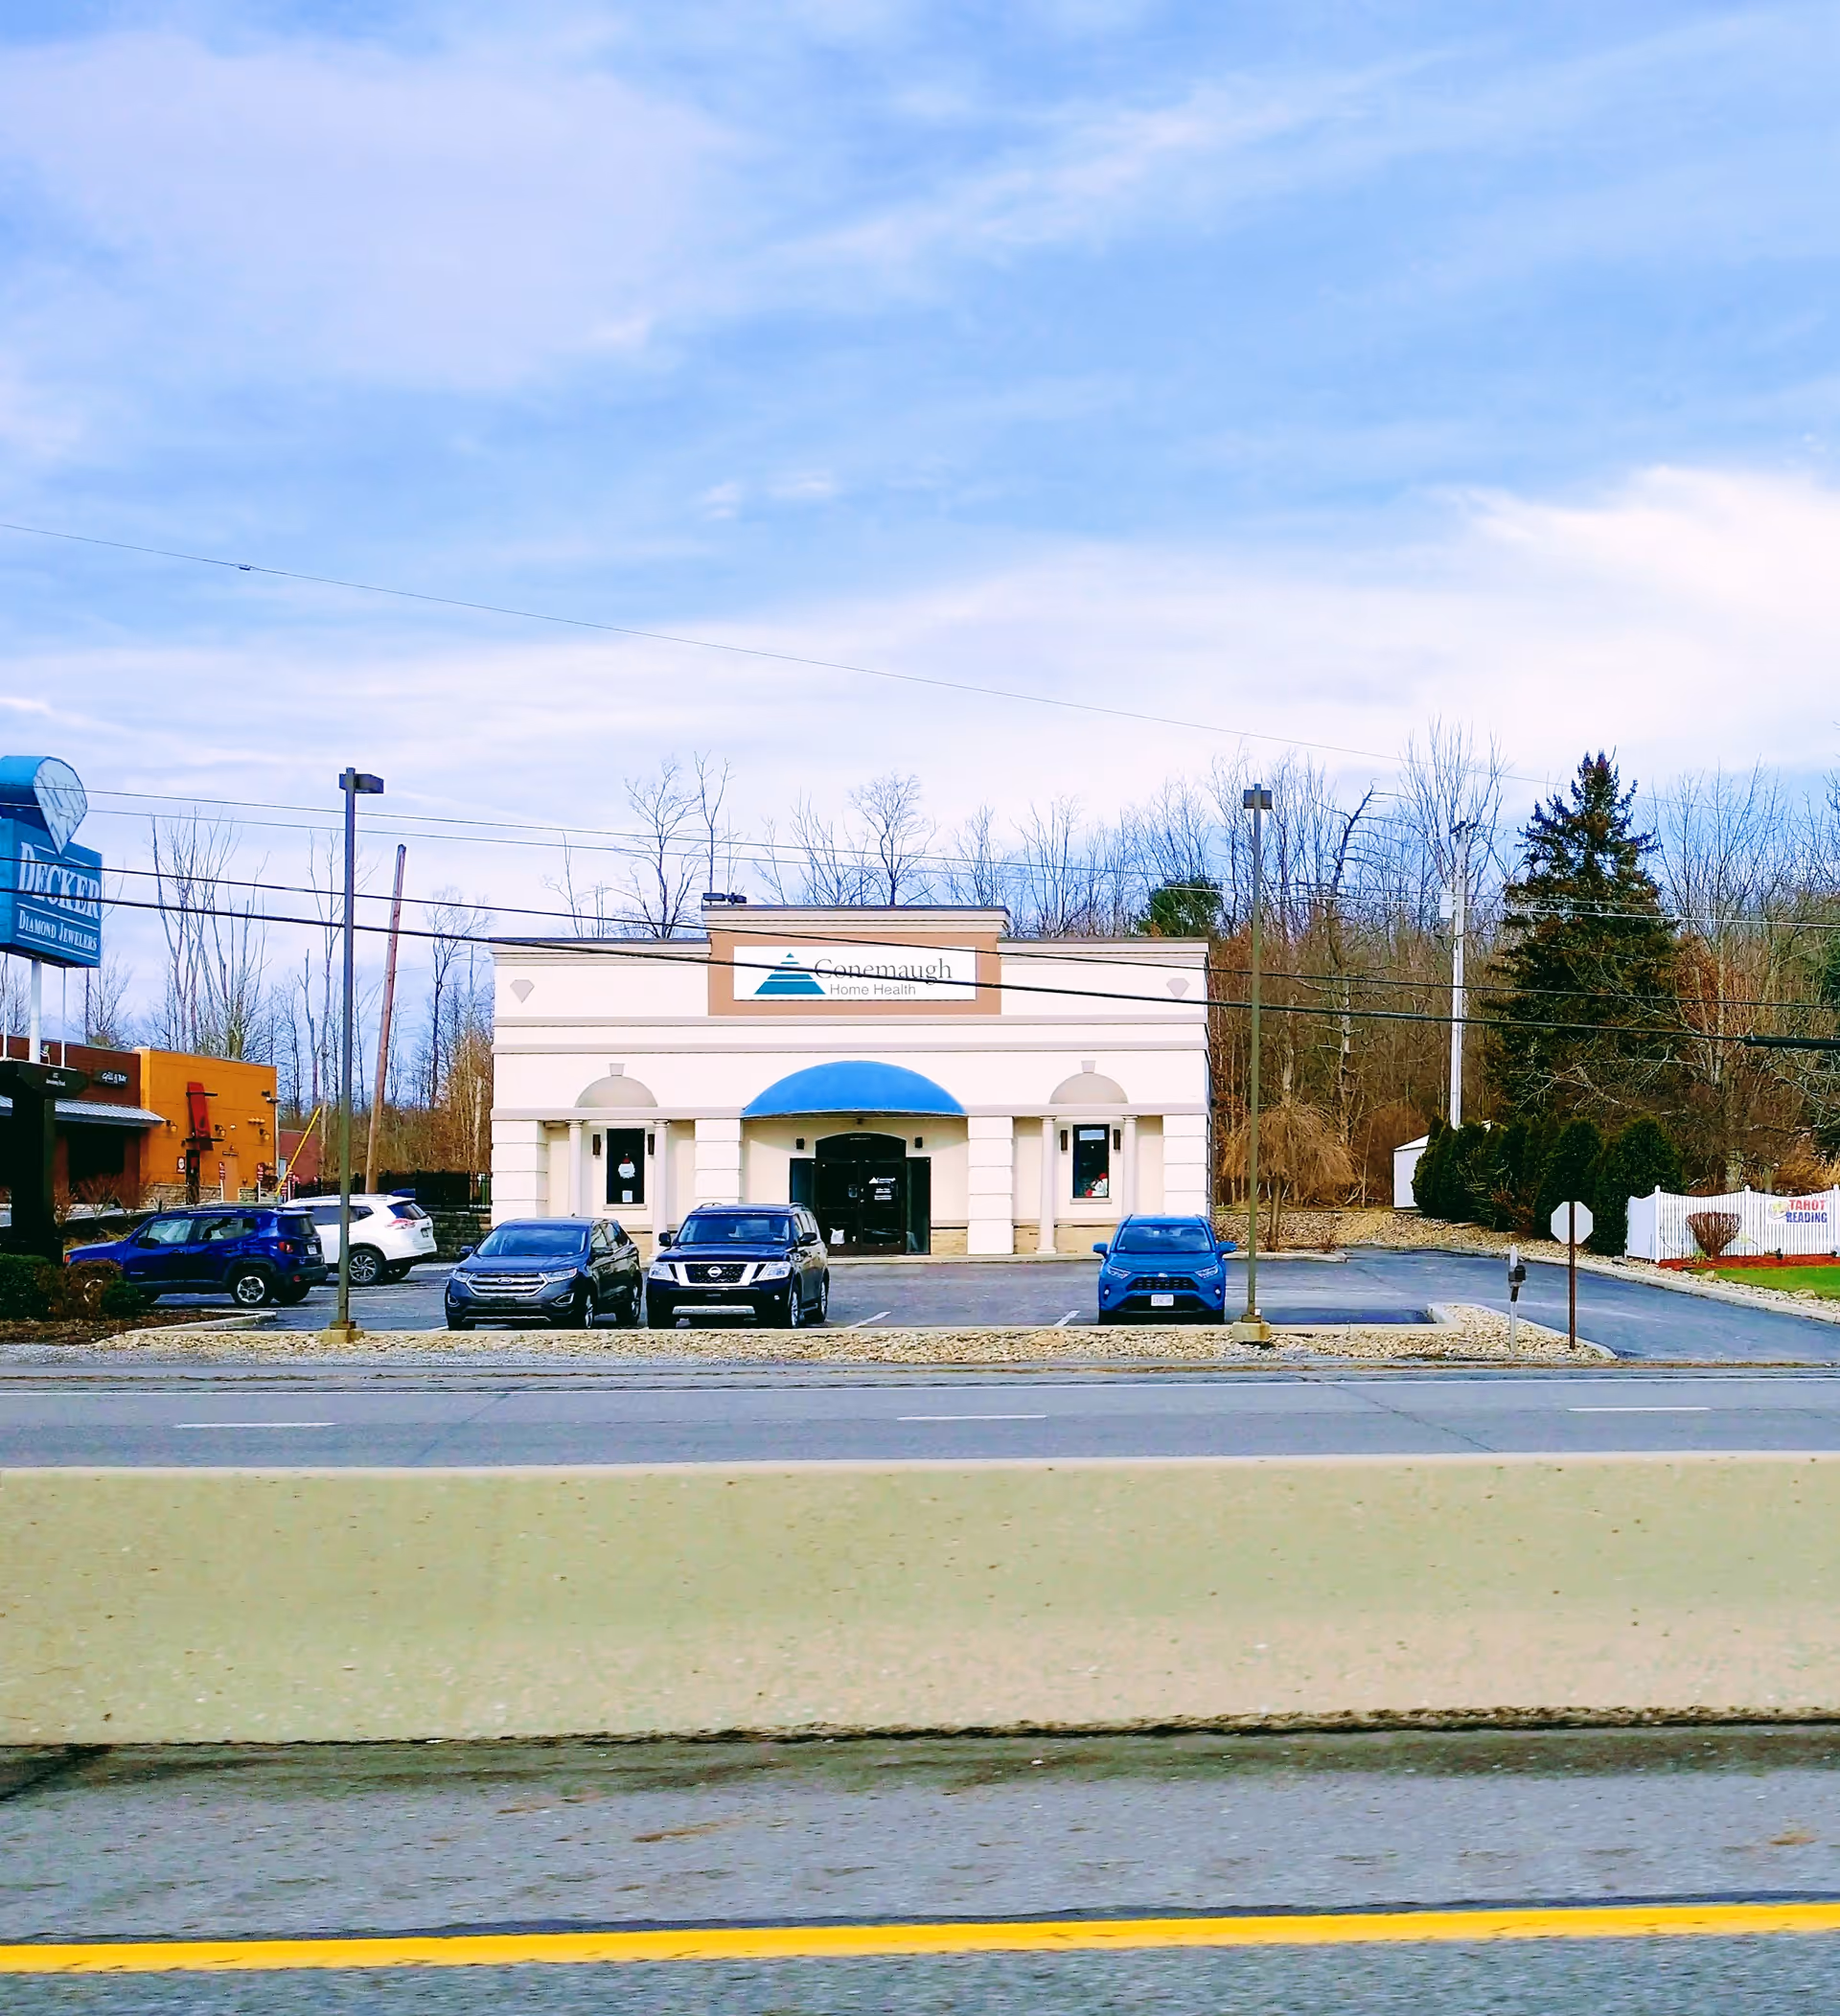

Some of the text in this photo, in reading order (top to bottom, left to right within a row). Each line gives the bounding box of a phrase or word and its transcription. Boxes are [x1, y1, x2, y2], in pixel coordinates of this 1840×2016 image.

[17, 841, 100, 920] DECKER
[18, 909, 98, 951] DIAMOND JEWELERS
[814, 958, 953, 985] Conemaugh
[830, 983, 916, 996] Home Health
